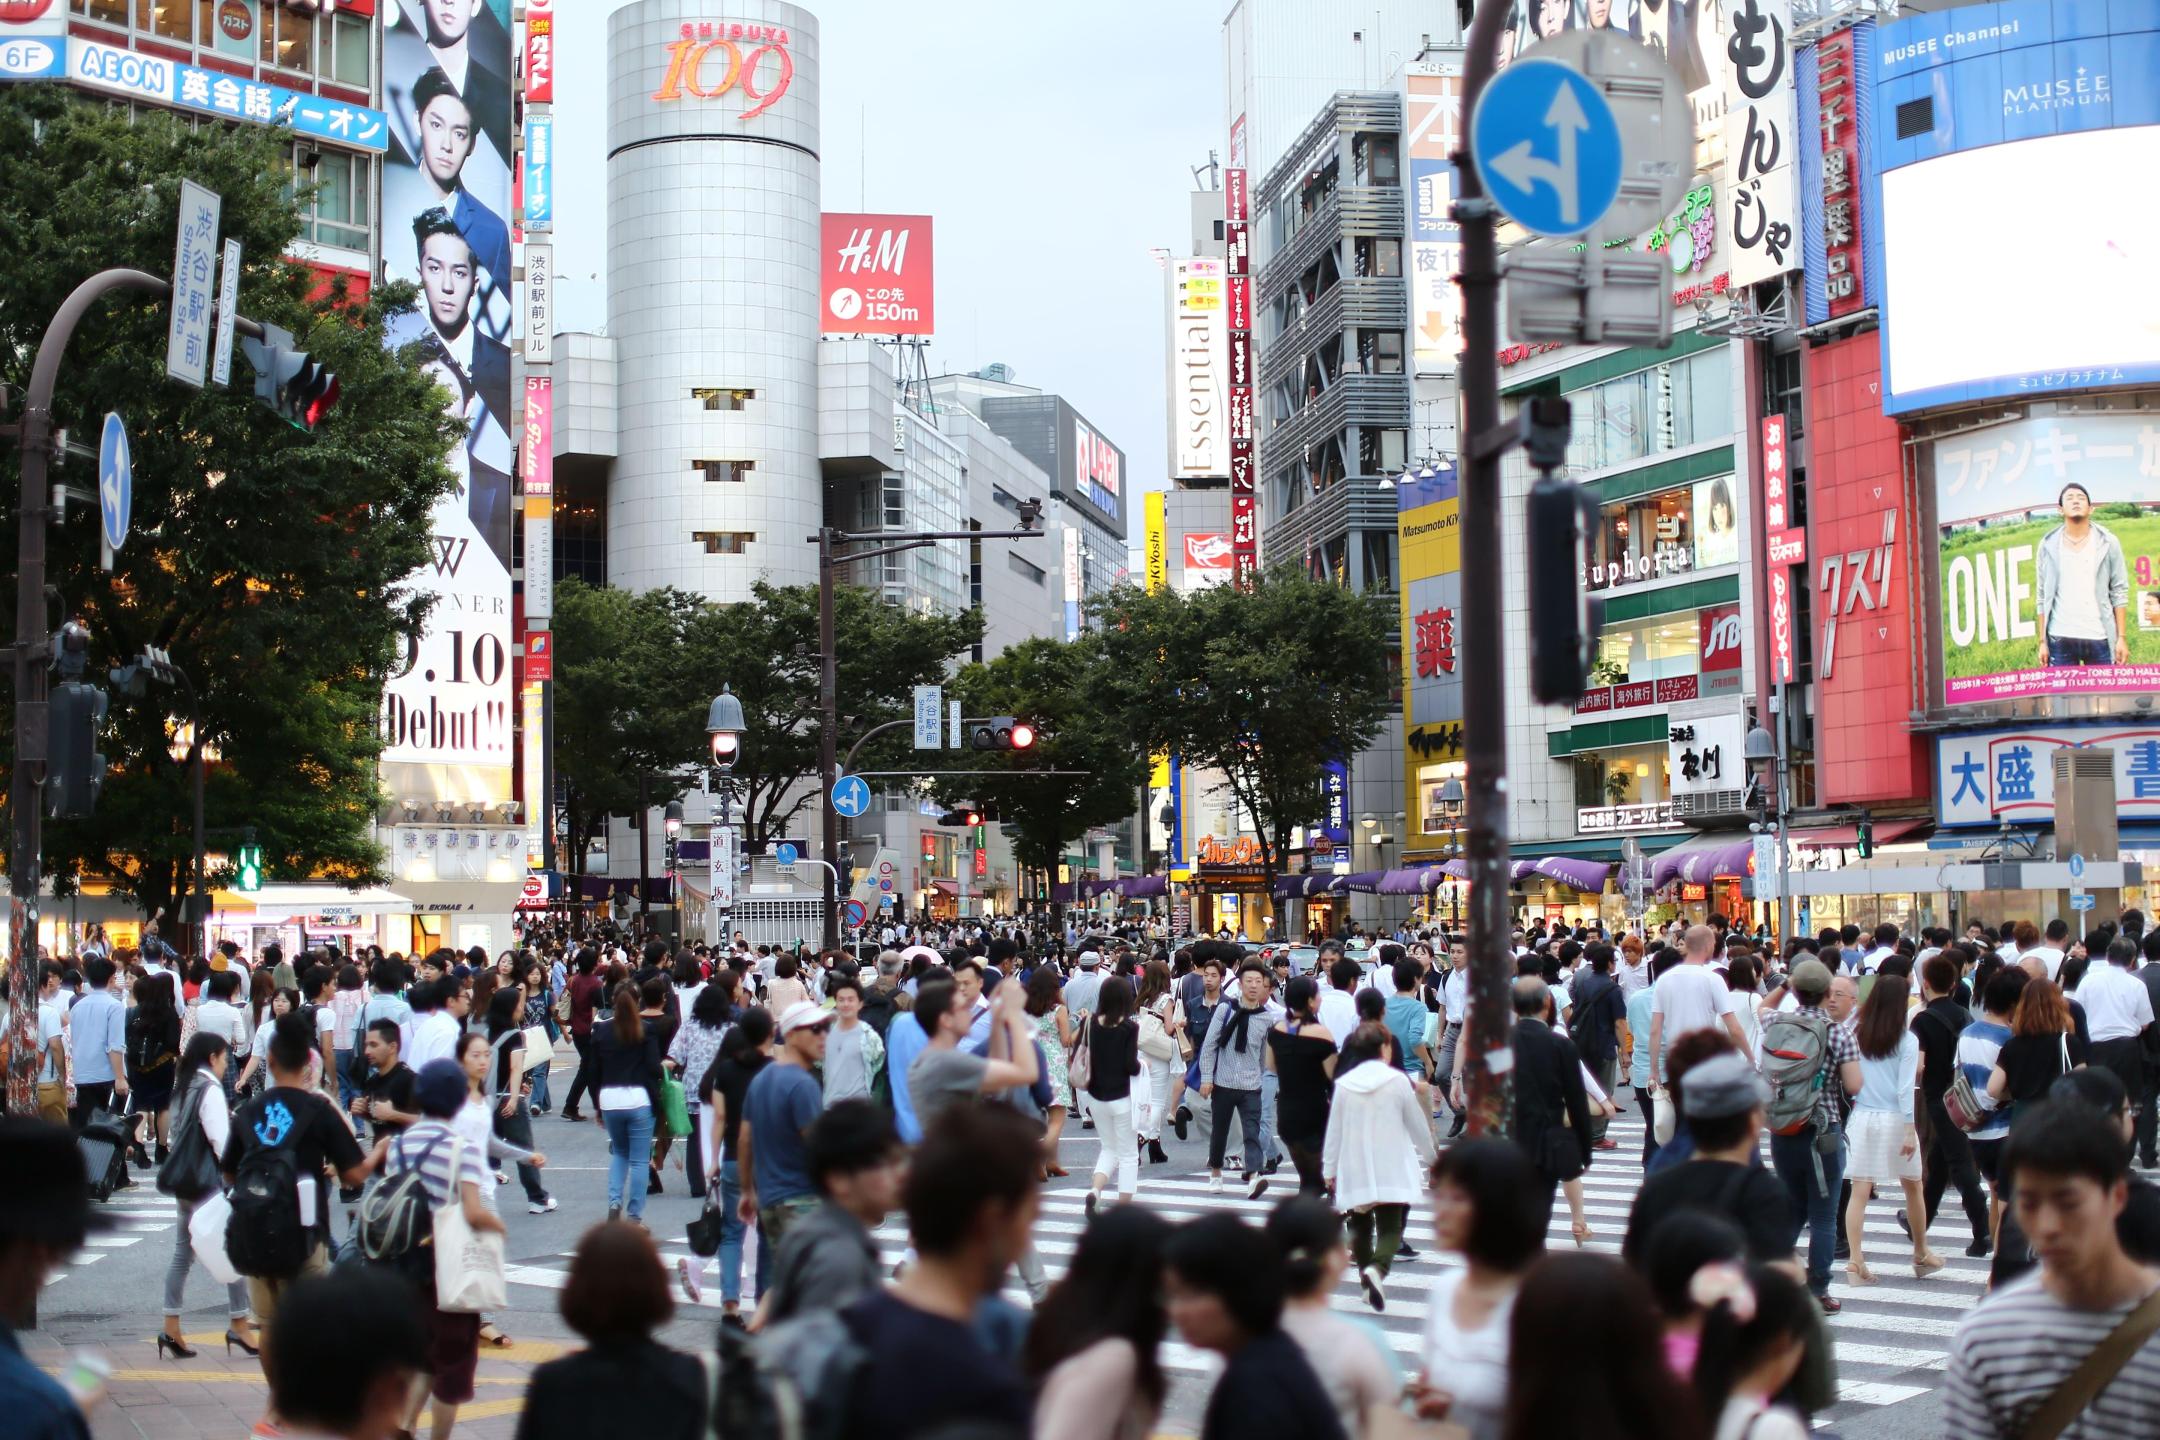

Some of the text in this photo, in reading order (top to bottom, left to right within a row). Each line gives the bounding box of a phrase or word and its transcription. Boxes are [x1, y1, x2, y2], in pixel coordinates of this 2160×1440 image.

[680, 22, 790, 45] SHIBUYA
[1883, 20, 2020, 66] MUSEE Channel
[6, 46, 42, 68] 6F
[81, 45, 165, 93] AEON
[530, 34, 549, 89] ガスト
[651, 38, 793, 120] 109
[2003, 93, 2110, 116] PLATINUM
[1728, 0, 1792, 266] もんじゃ
[1418, 180, 1432, 215] BOOK
[532, 222, 545, 231] 6F
[179, 223, 194, 298] Shibuya
[838, 227, 909, 276] H&M
[531, 256, 546, 352] 渋谷駅前ビル
[865, 287, 905, 301] この先
[865, 302, 919, 321] 150m
[1179, 315, 1212, 471] Essential
[2018, 367, 2124, 388] ミュゼプラチナム
[1089, 430, 1119, 497] LABI
[1767, 423, 1784, 526] お好み焼
[1402, 519, 1446, 538] Matsumoto
[1819, 508, 1897, 679] クスリ
[1947, 545, 2037, 647] ONE
[1415, 606, 1455, 678] 薬
[1704, 613, 1741, 660] JTB
[1616, 686, 1651, 704] 海外旅行
[1658, 688, 1697, 702] ウエディング
[1660, 677, 1694, 691] ハネムーン
[2097, 678, 2116, 686] YOU
[2114, 668, 2134, 677] FOR
[926, 691, 937, 744] 渋谷駅前
[1951, 740, 2160, 807] 大盛書
[404, 832, 520, 849] 渋谷駅前ビル
[713, 834, 724, 899] 道玄坂
[428, 903, 463, 911] EKIMAE
[1172, 906, 1180, 936] KIRIN
